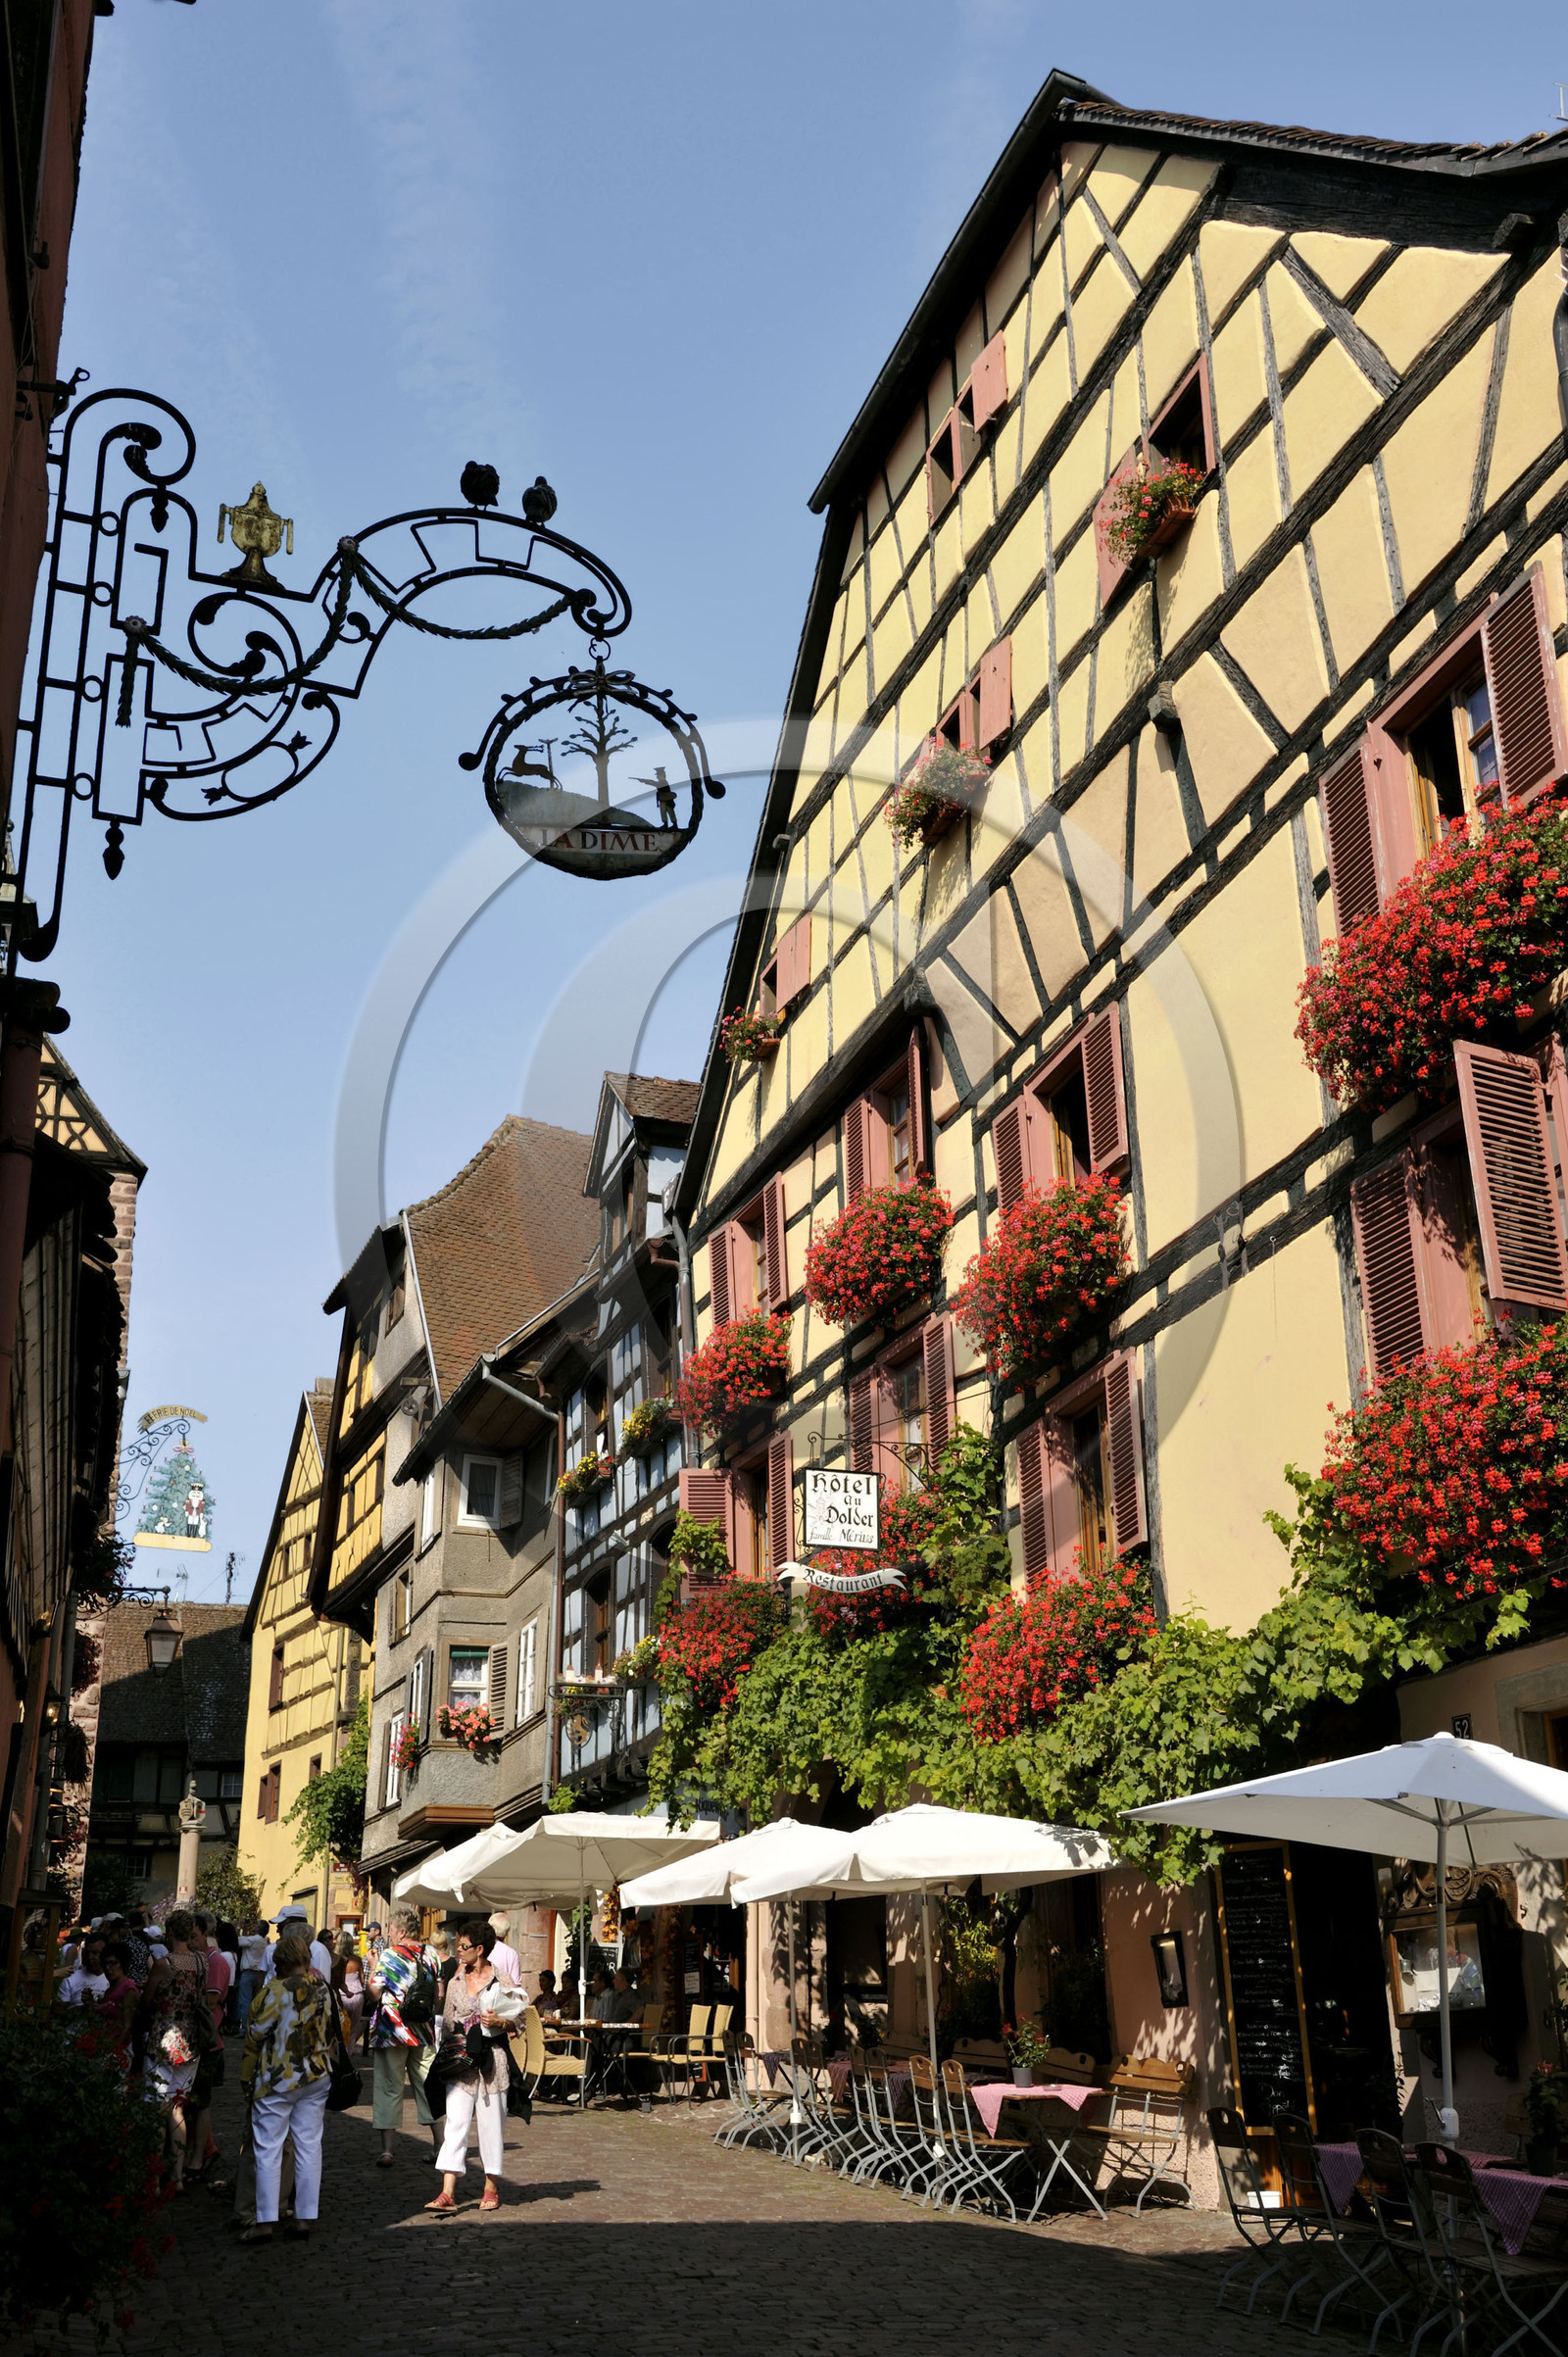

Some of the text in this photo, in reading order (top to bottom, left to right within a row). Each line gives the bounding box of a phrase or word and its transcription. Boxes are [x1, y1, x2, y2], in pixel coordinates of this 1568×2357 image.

[541, 828, 659, 853] LA DIME
[170, 1406, 179, 1416] DE
[811, 1472, 872, 1496] Hôtel
[826, 1503, 874, 1528] Dolder
[803, 1569, 884, 1592] Restaurant
[1455, 1719, 1471, 1739] 52
